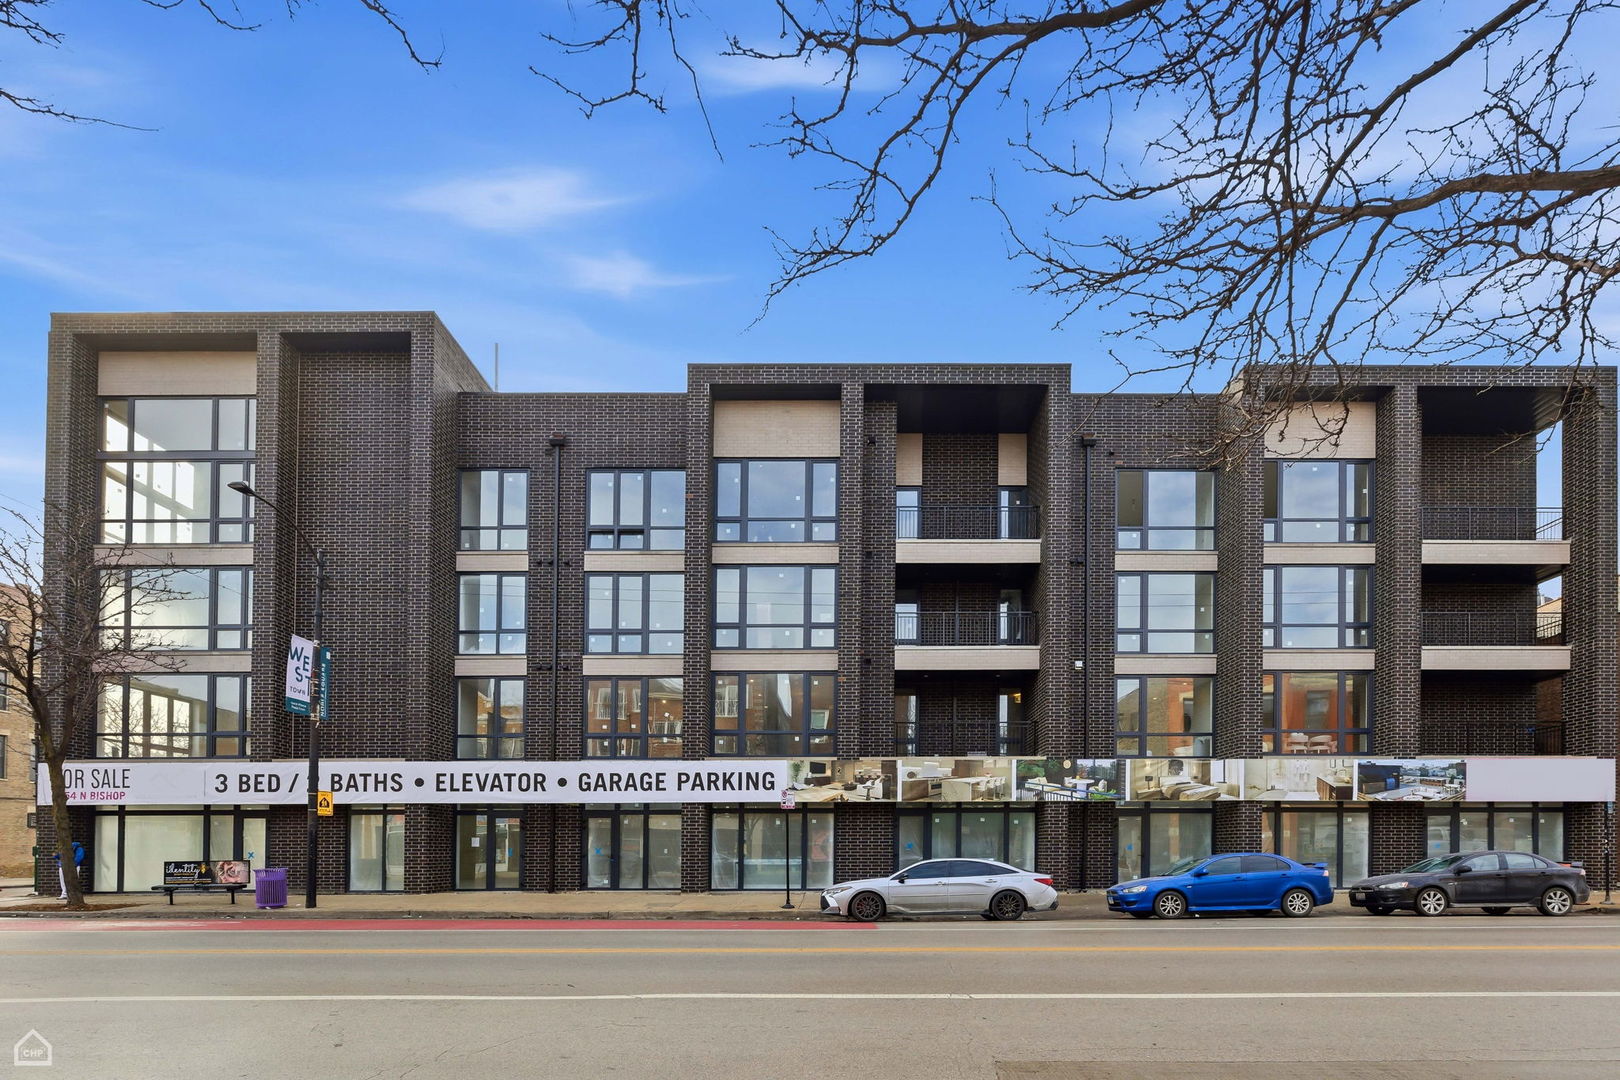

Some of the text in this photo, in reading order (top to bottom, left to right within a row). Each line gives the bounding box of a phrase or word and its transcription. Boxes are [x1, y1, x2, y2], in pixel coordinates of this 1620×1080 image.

[63, 768, 131, 789] OR SALE
[215, 773, 228, 793] 3
[238, 773, 281, 793] BED
[288, 773, 300, 793] /
[330, 773, 403, 793] BATHS
[435, 772, 547, 793] ELEVATOR
[578, 771, 775, 792] GARAGE PARKING
[64, 791, 126, 800] 54 N BISHOP
